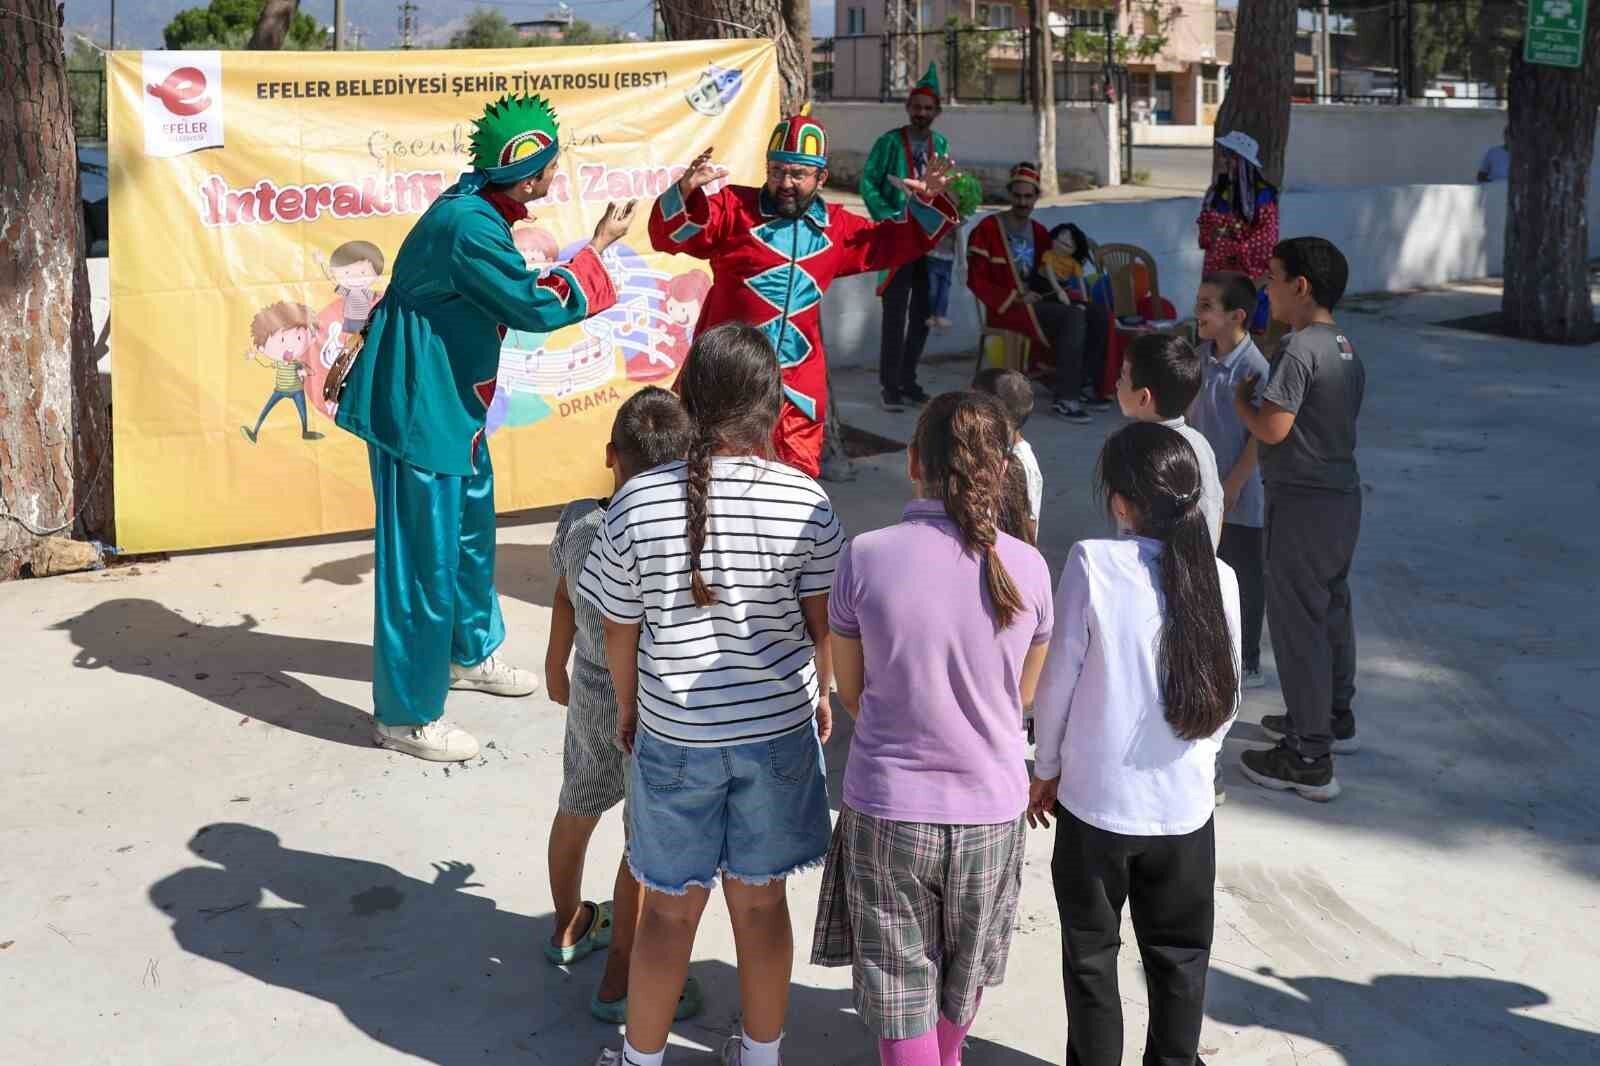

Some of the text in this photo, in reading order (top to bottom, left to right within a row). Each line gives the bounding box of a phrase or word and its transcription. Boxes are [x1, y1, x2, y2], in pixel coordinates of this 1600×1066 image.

[256, 71, 668, 99] EFELER BELEDİYESİ ŞEHİR TİYATROSU (EBST)
[558, 387, 621, 418] DRAMA
